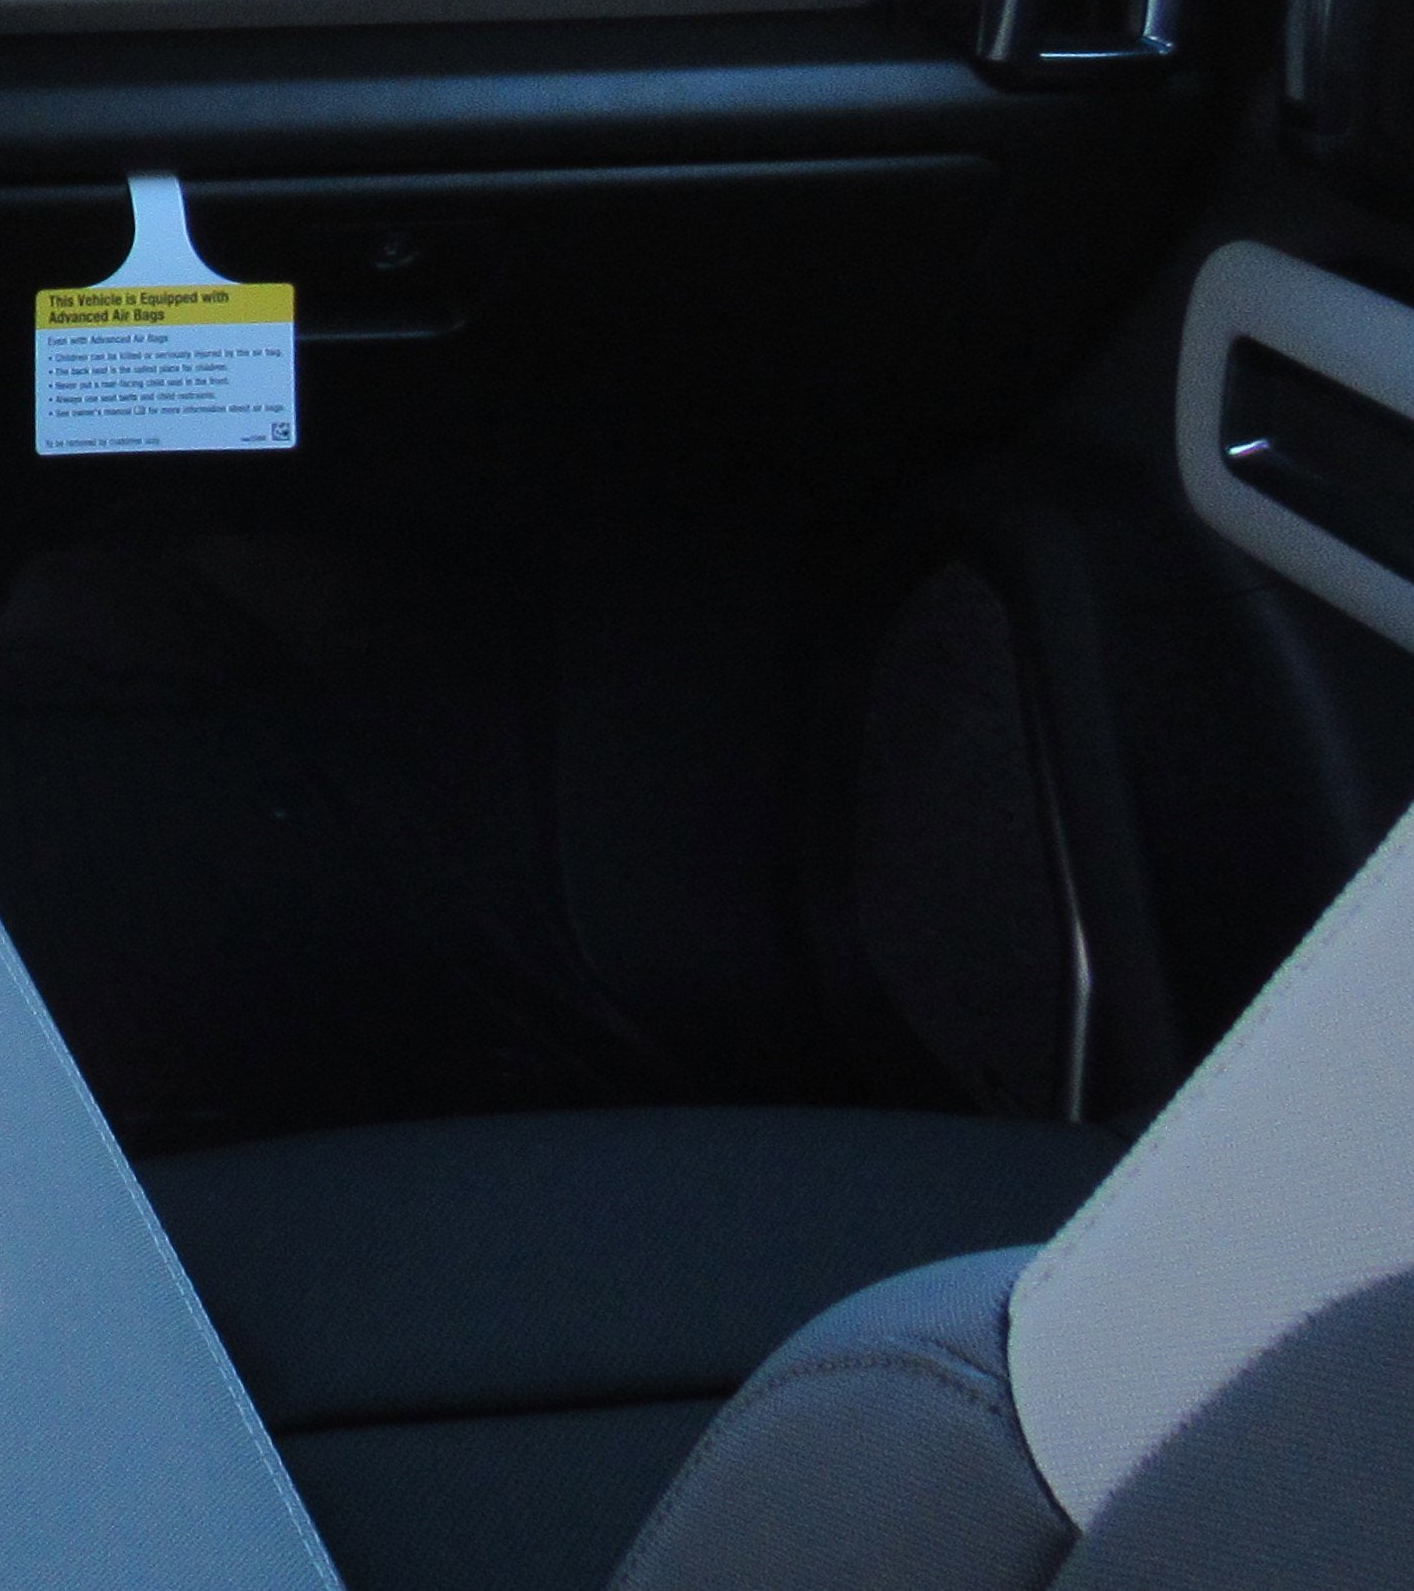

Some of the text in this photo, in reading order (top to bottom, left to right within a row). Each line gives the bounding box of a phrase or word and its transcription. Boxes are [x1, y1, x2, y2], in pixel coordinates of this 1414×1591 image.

[49, 291, 229, 307] This Vehicle is Equipped with
[49, 309, 165, 323] Advanced Air Bags
